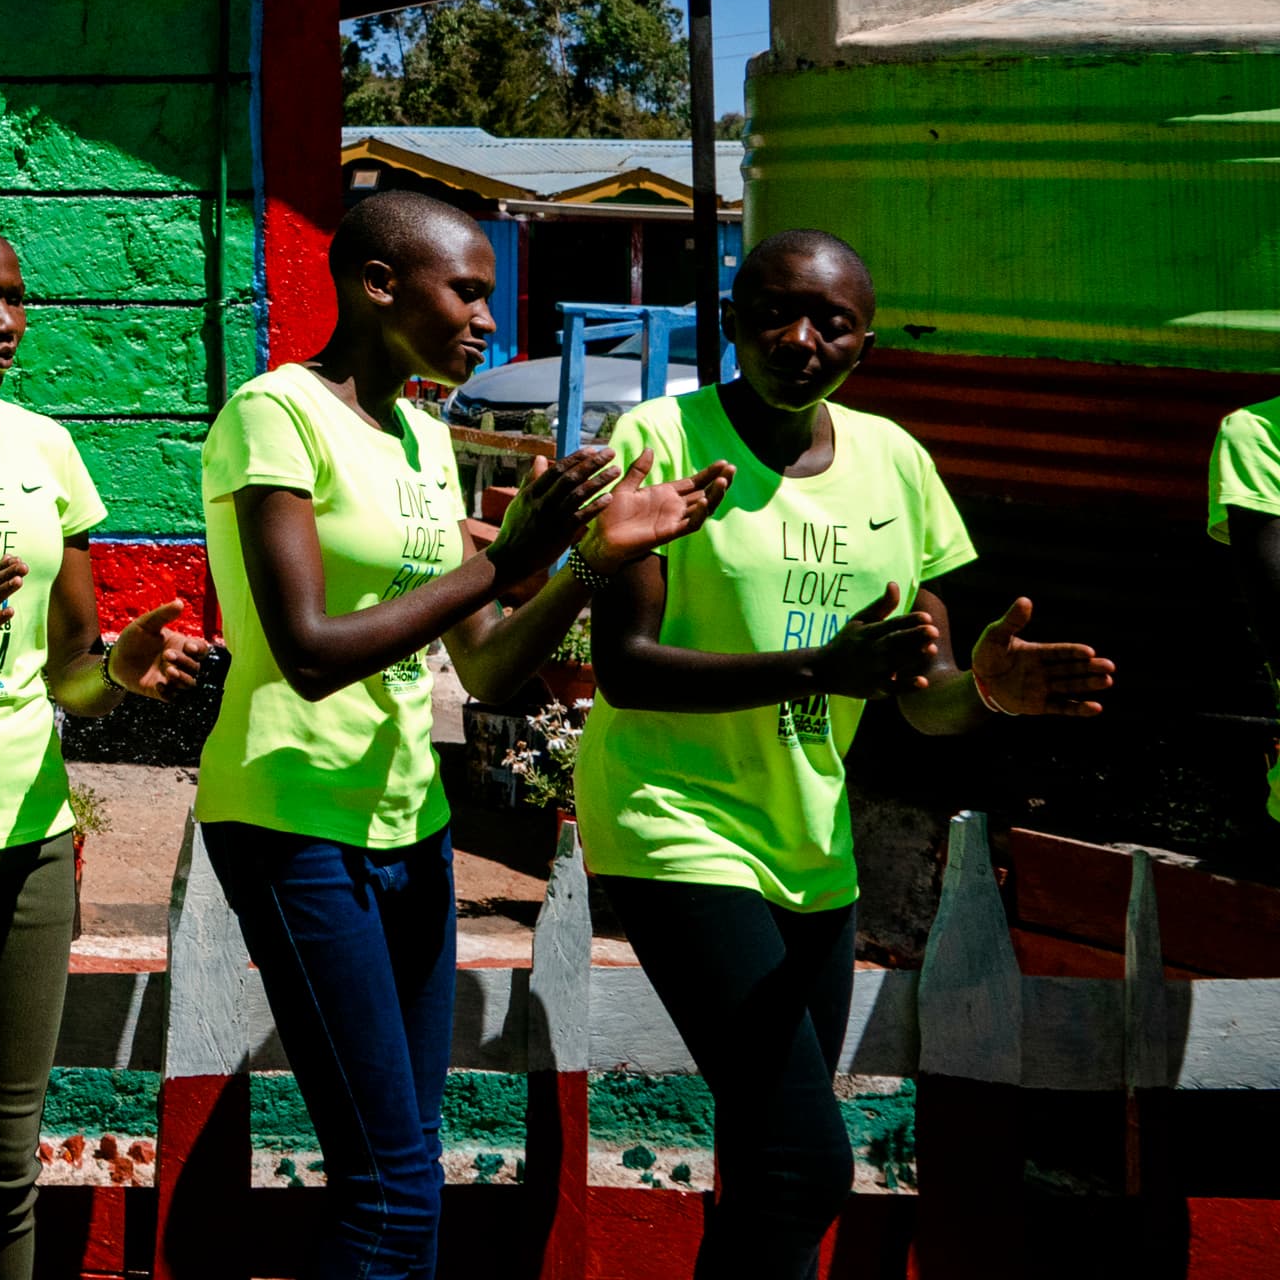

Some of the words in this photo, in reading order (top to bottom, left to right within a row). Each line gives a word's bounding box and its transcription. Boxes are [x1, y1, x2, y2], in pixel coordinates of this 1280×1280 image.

[395, 478, 439, 521] LIVE
[401, 525, 446, 562] LOVE
[782, 521, 849, 566] LIVE
[781, 569, 855, 608] LOVE
